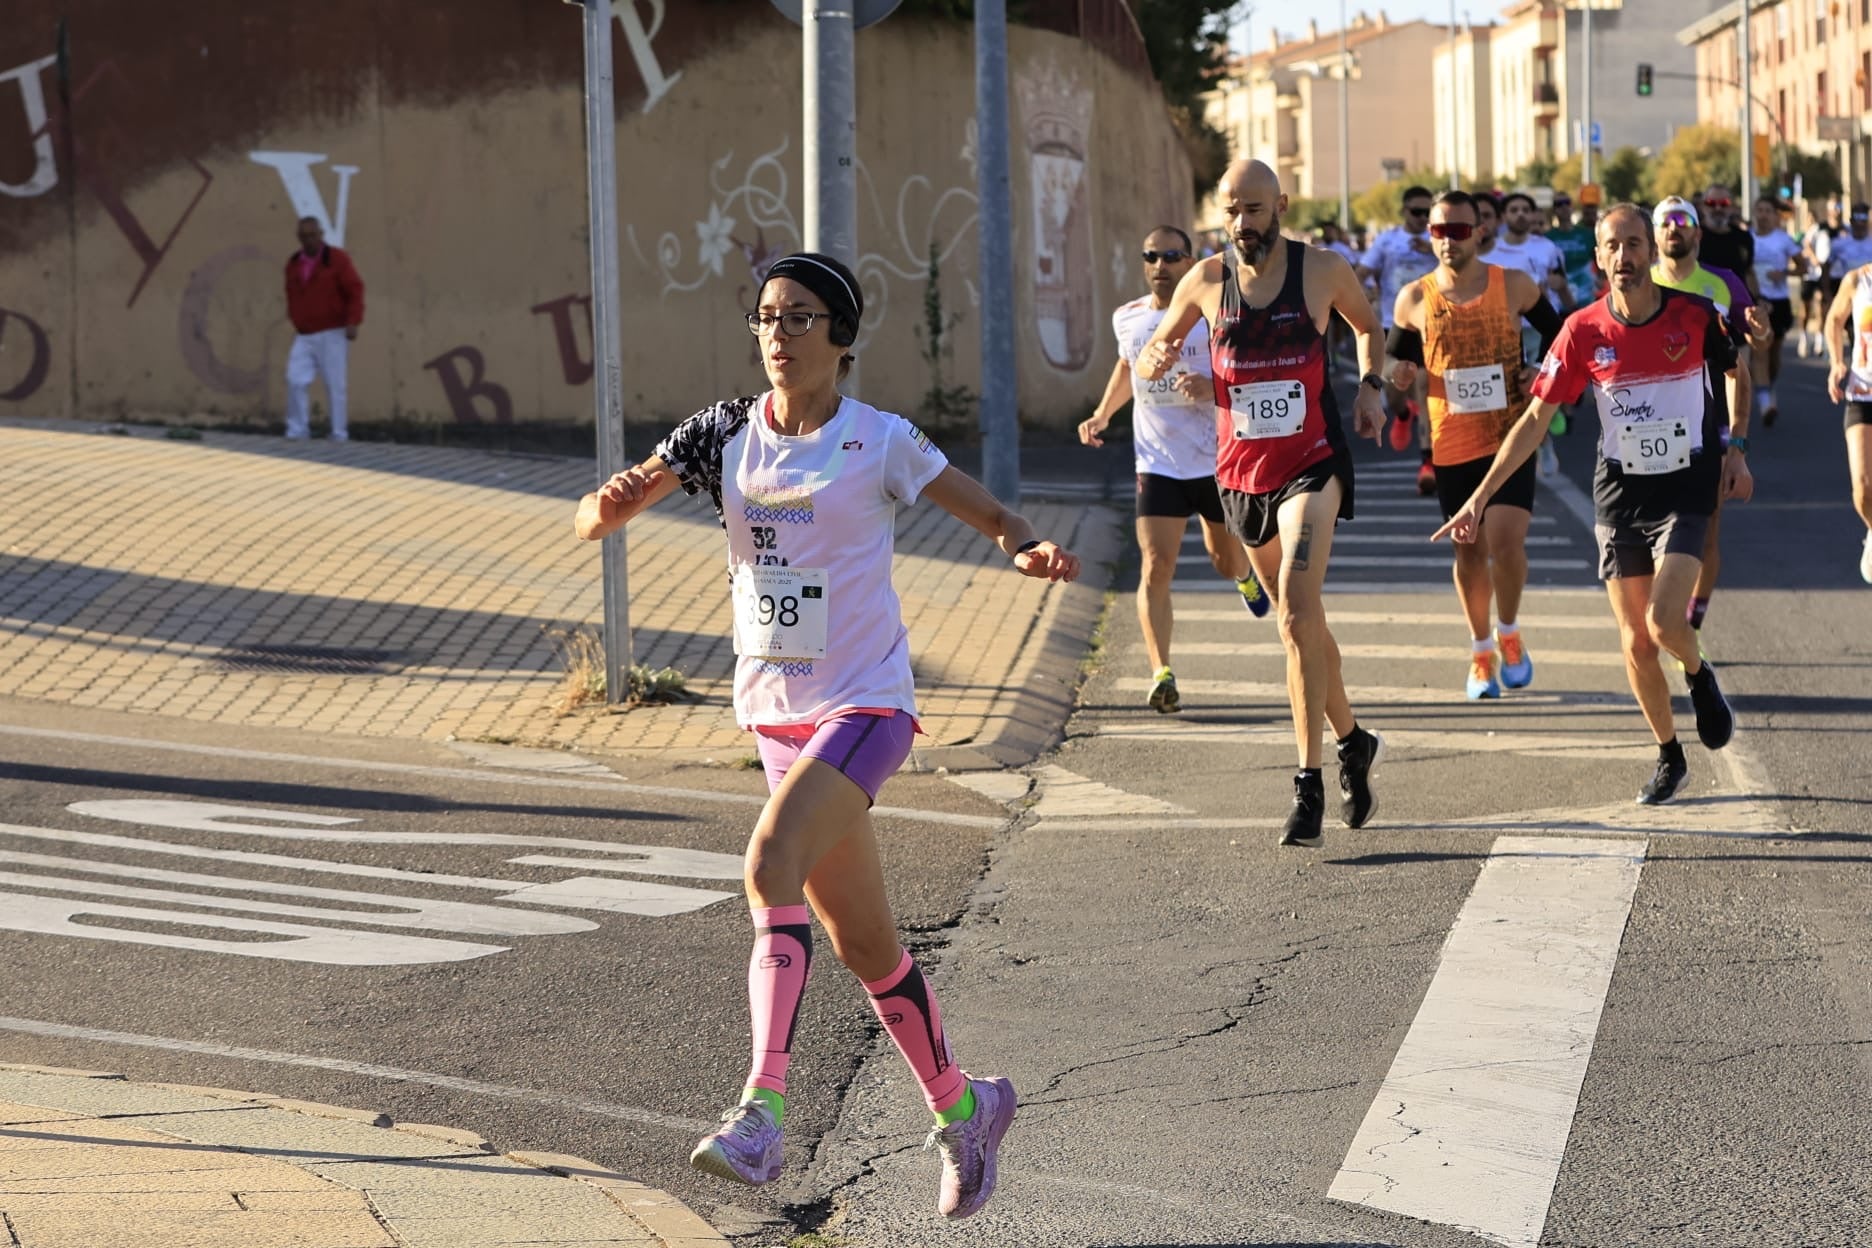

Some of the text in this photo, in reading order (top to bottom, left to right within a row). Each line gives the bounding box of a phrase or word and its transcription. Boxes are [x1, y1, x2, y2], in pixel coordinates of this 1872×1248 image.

[1457, 380, 1493, 399] 525
[1248, 398, 1289, 420] 189
[1610, 388, 1655, 417] Simón
[1640, 437, 1668, 458] 50
[750, 526, 777, 549] 32
[748, 594, 799, 627] 398
